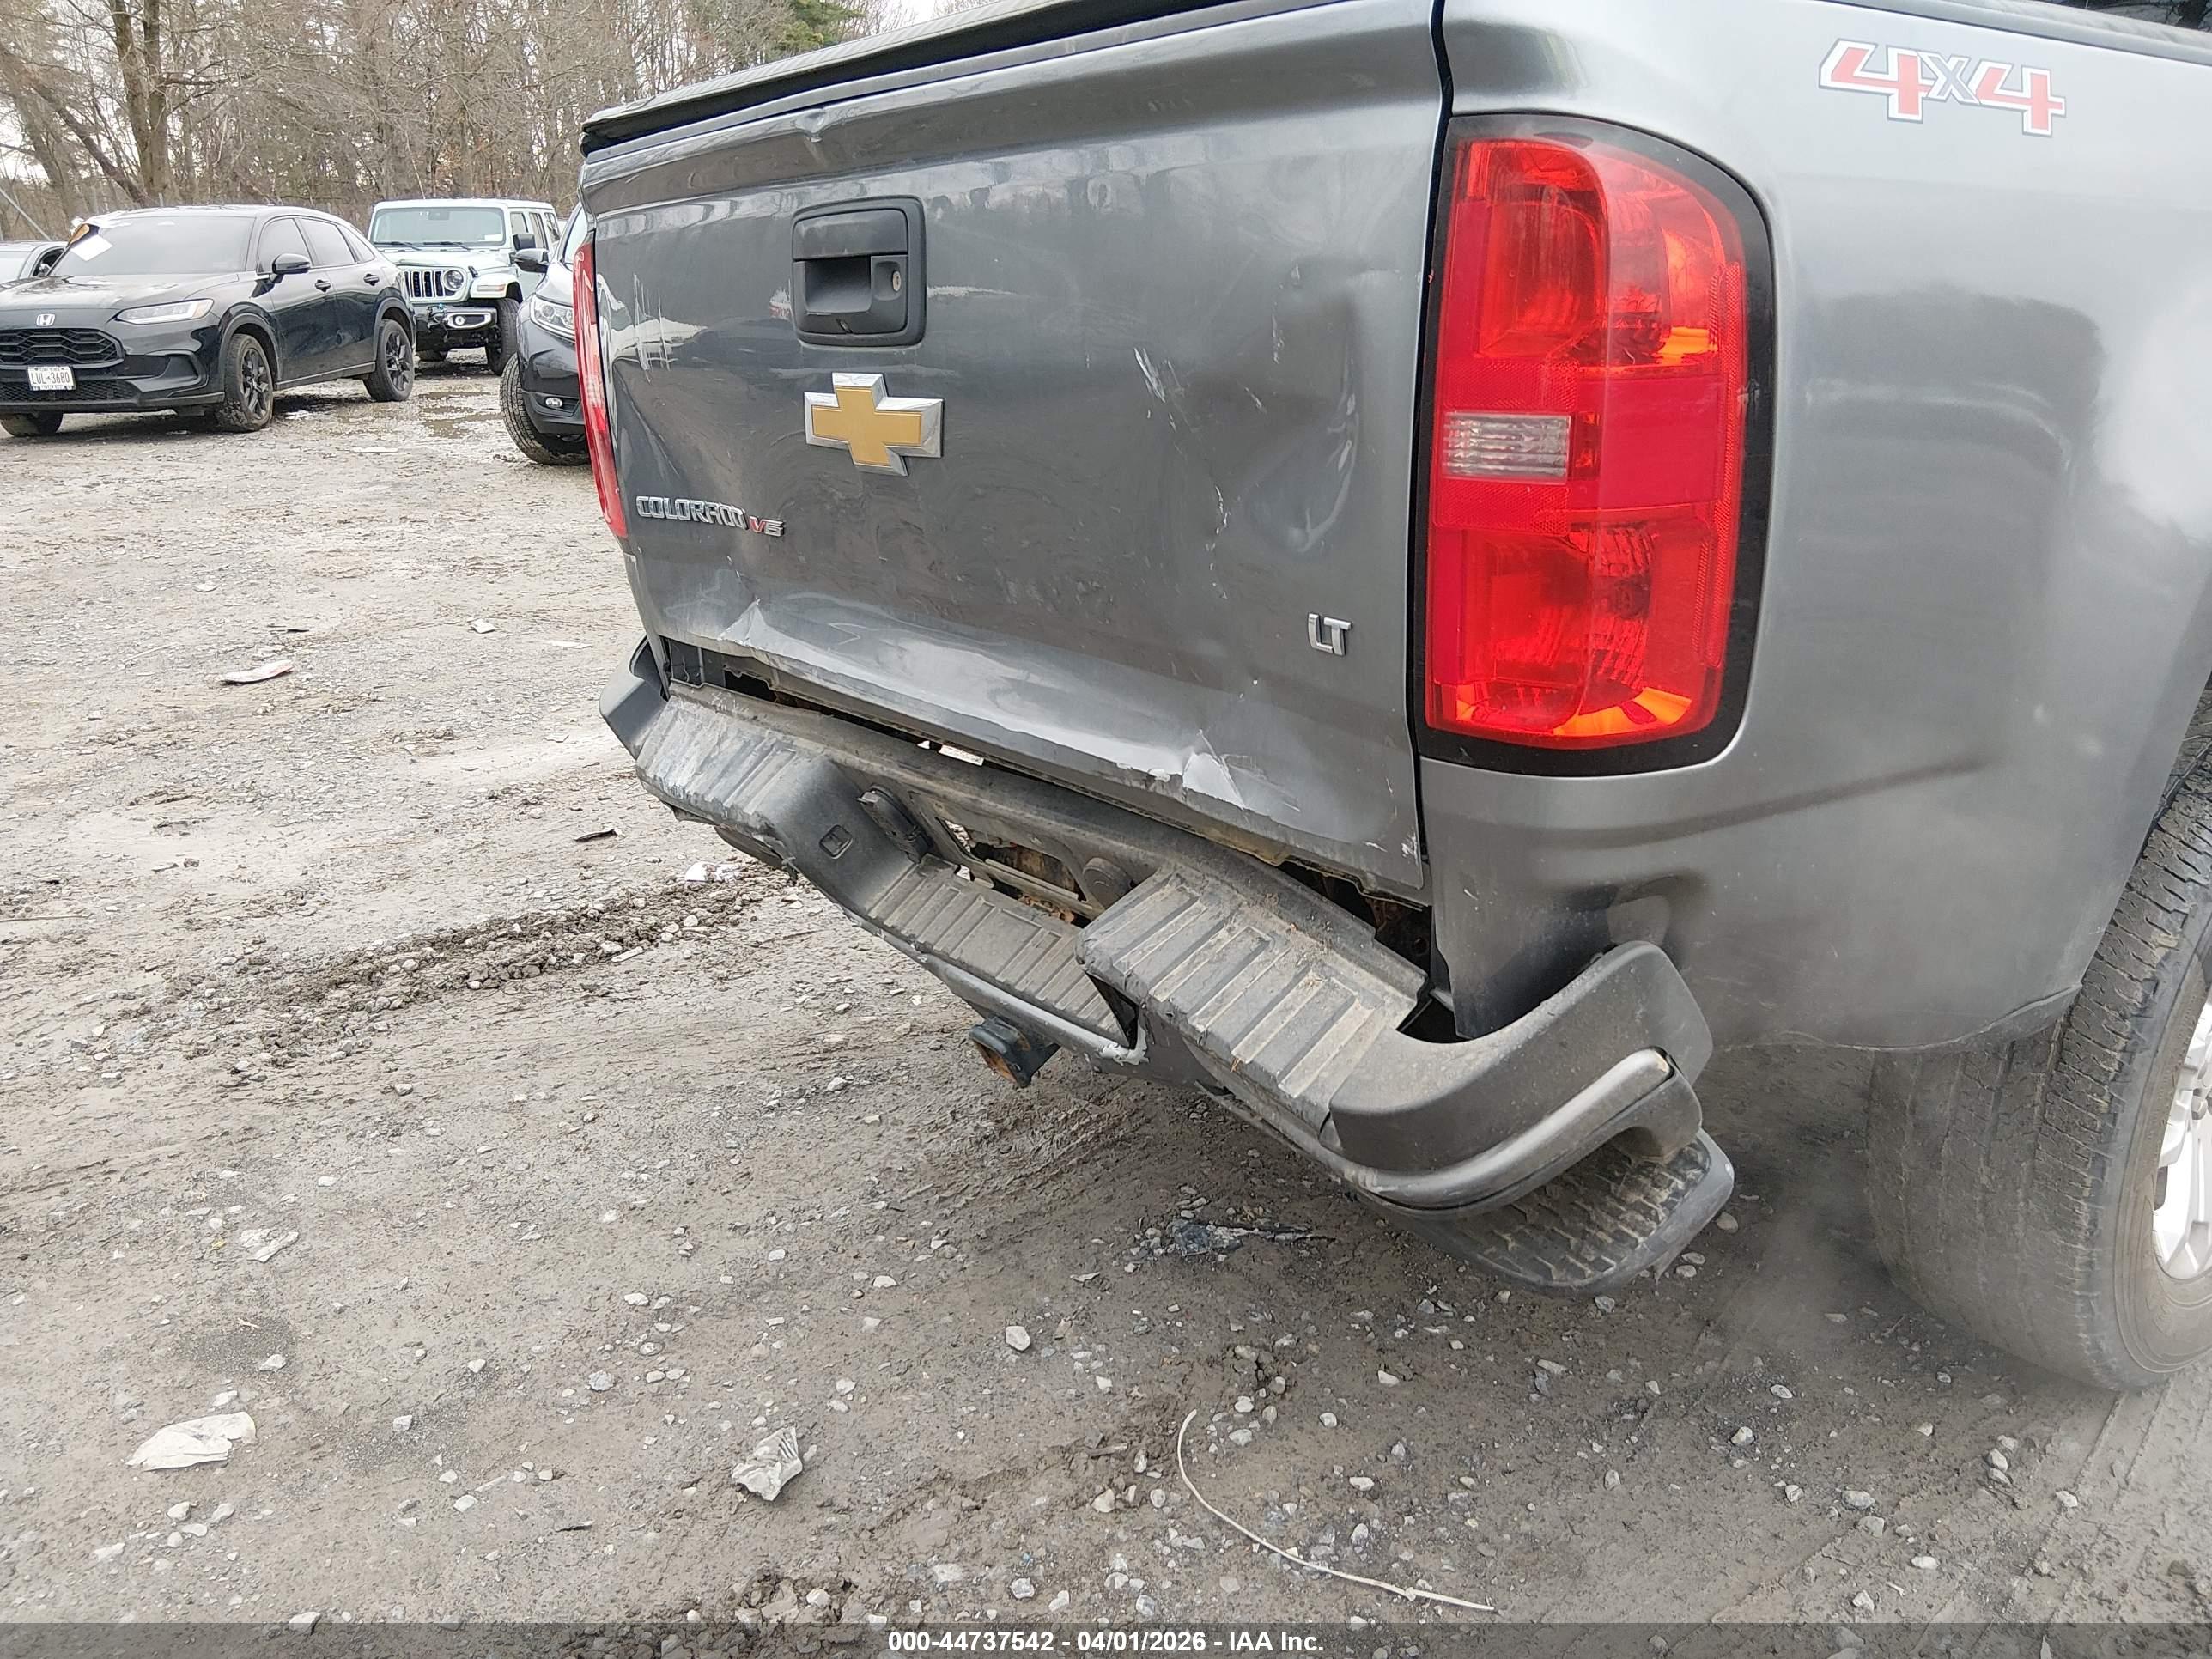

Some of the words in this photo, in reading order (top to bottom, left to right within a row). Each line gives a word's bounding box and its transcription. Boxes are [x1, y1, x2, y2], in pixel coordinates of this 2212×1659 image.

[636, 495, 748, 530] COLORADO
[749, 516, 785, 538] V6
[1308, 612, 1352, 657] LT
